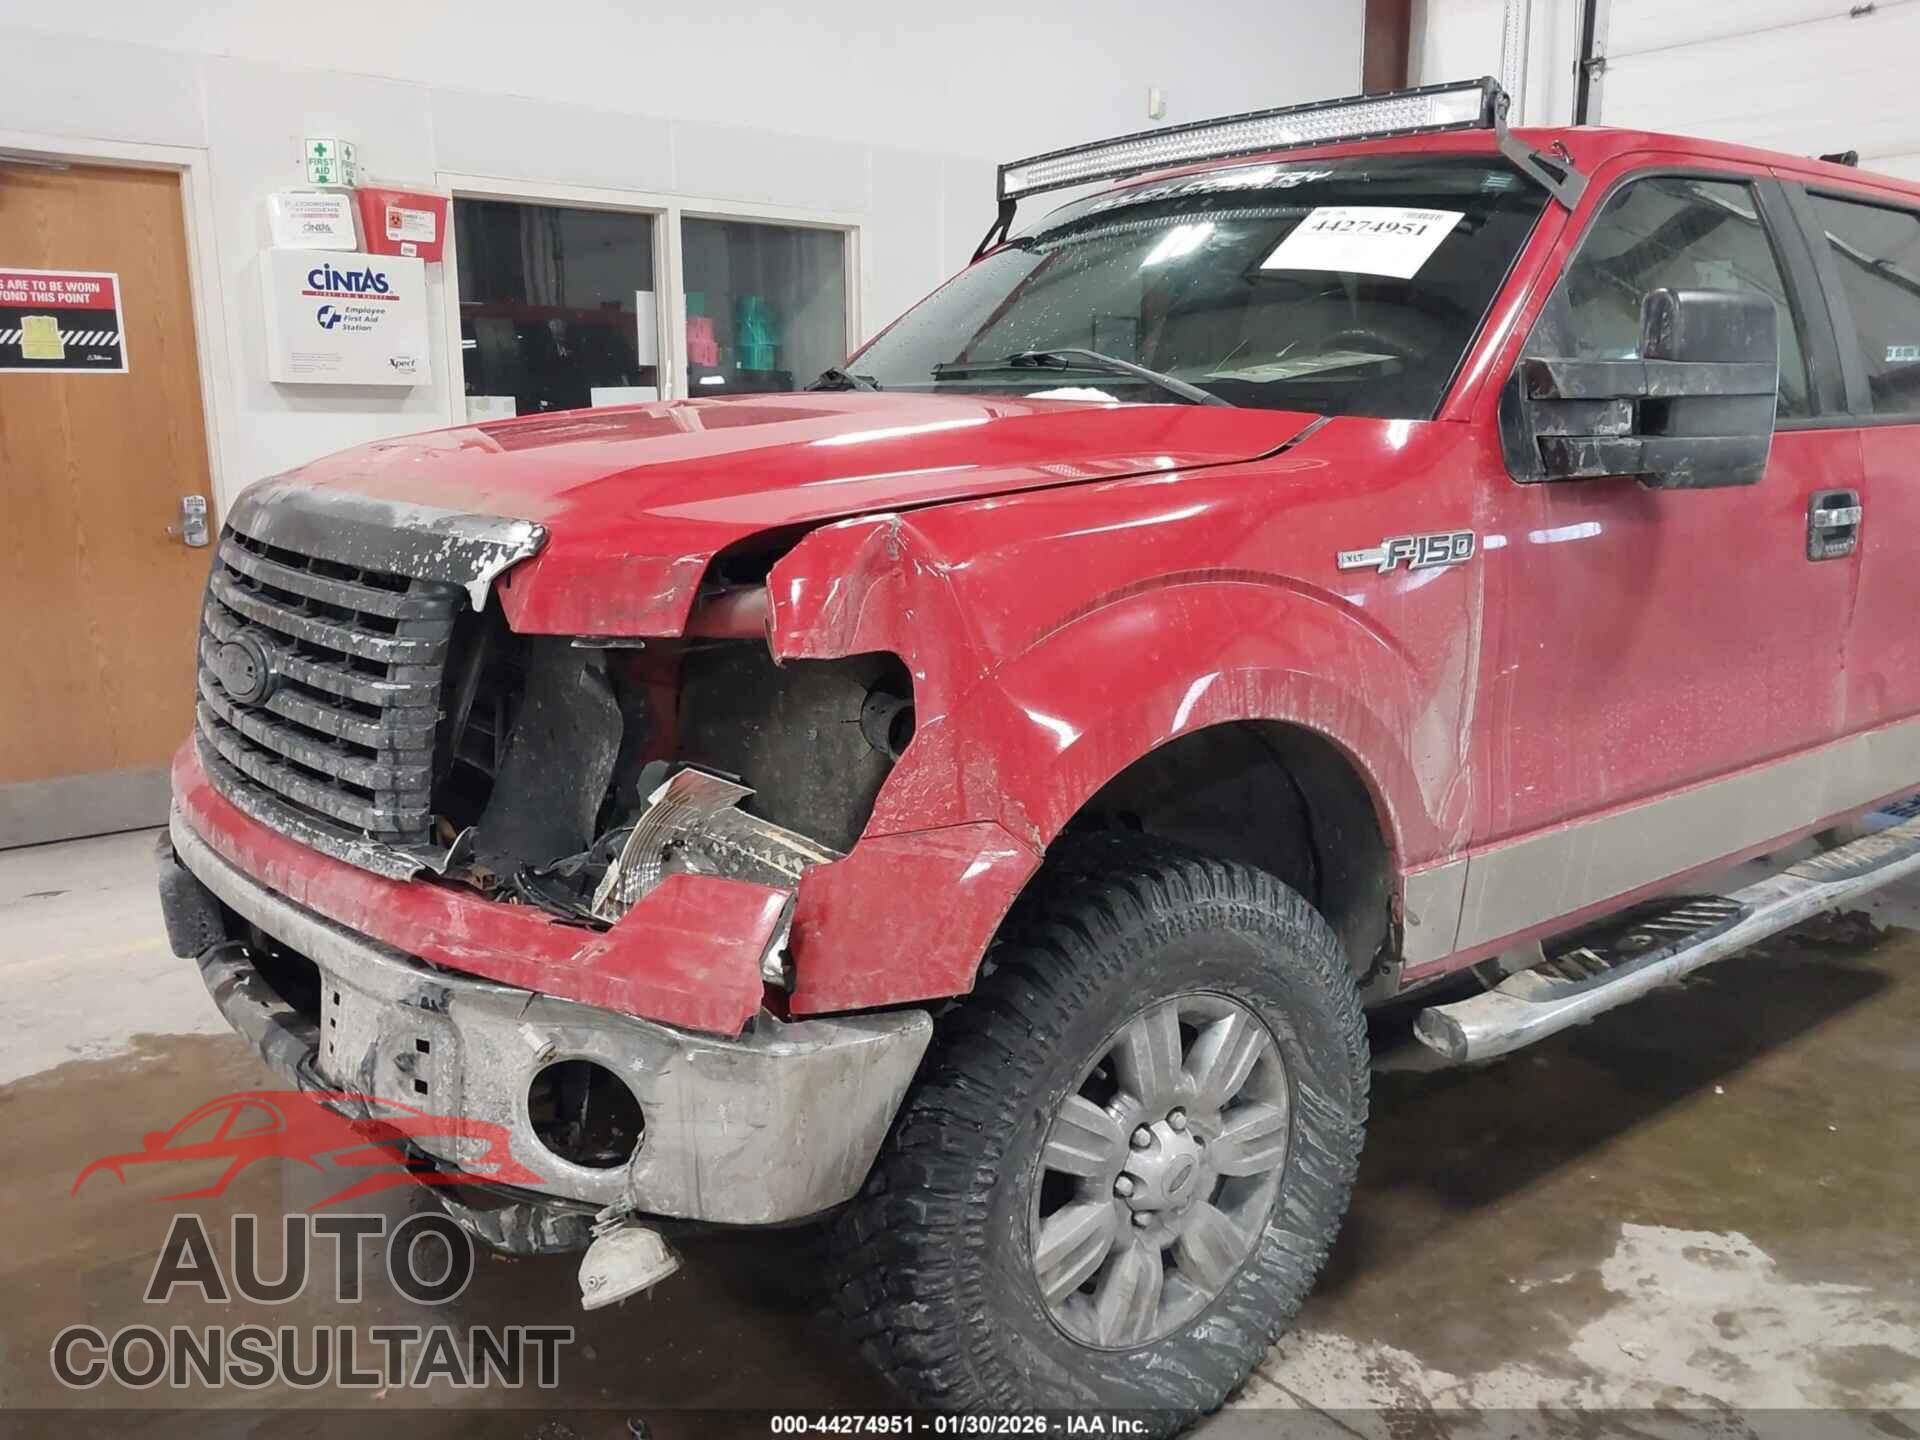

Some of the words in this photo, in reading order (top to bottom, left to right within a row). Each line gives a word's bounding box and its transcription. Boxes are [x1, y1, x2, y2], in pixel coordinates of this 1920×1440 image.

[315, 167, 330, 175] AID
[1312, 220, 1428, 236] 44274951
[7, 279, 29, 290] ARE
[32, 280, 46, 291] TO
[49, 281, 64, 292] BE
[65, 282, 100, 293] WORN
[30, 292, 55, 303] THIS
[58, 293, 90, 304] POINT
[345, 306, 386, 316] Employee
[364, 315, 379, 323] Aid
[1346, 553, 1364, 562] XLT
[1380, 530, 1475, 572] F-150
